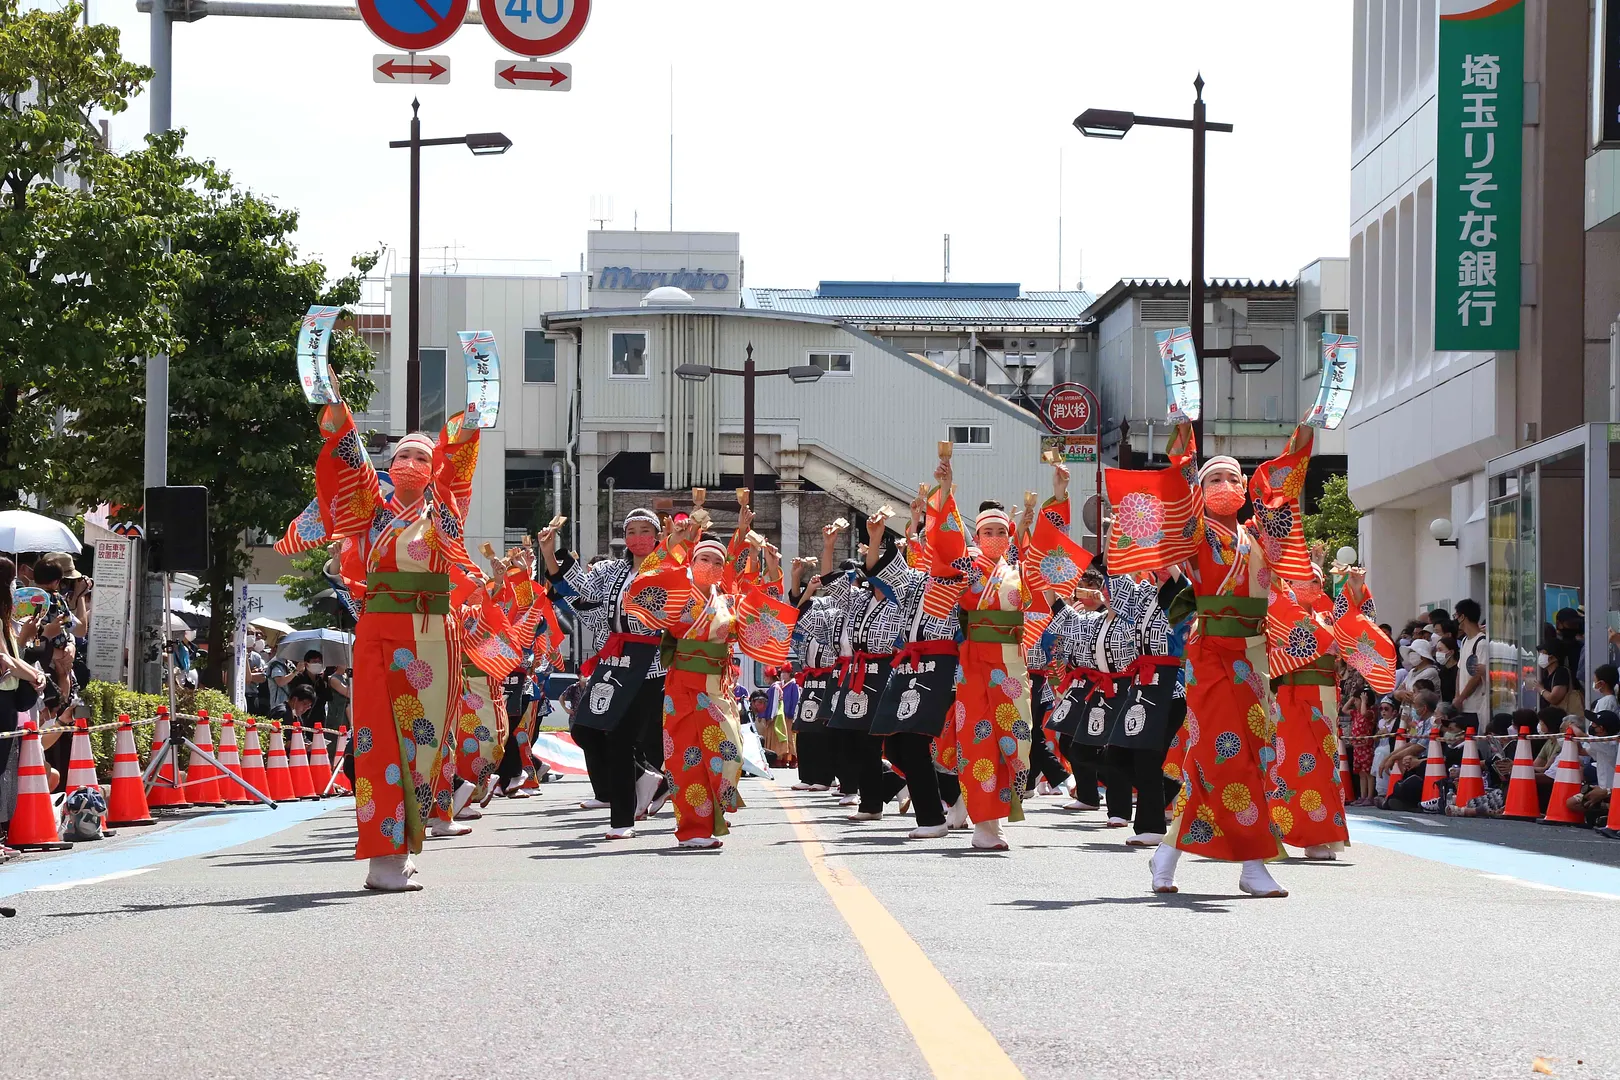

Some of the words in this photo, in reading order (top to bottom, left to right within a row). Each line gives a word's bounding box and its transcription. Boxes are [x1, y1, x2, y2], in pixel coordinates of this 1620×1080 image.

[505, 0, 564, 24] 40
[1458, 54, 1500, 327] 埼玉りそな銀行
[1053, 402, 1086, 419] 消火栓
[1068, 445, 1094, 454] Asha
[98, 551, 125, 560] 放置禁止
[99, 543, 126, 551] 自転車等
[247, 596, 264, 613] 科
